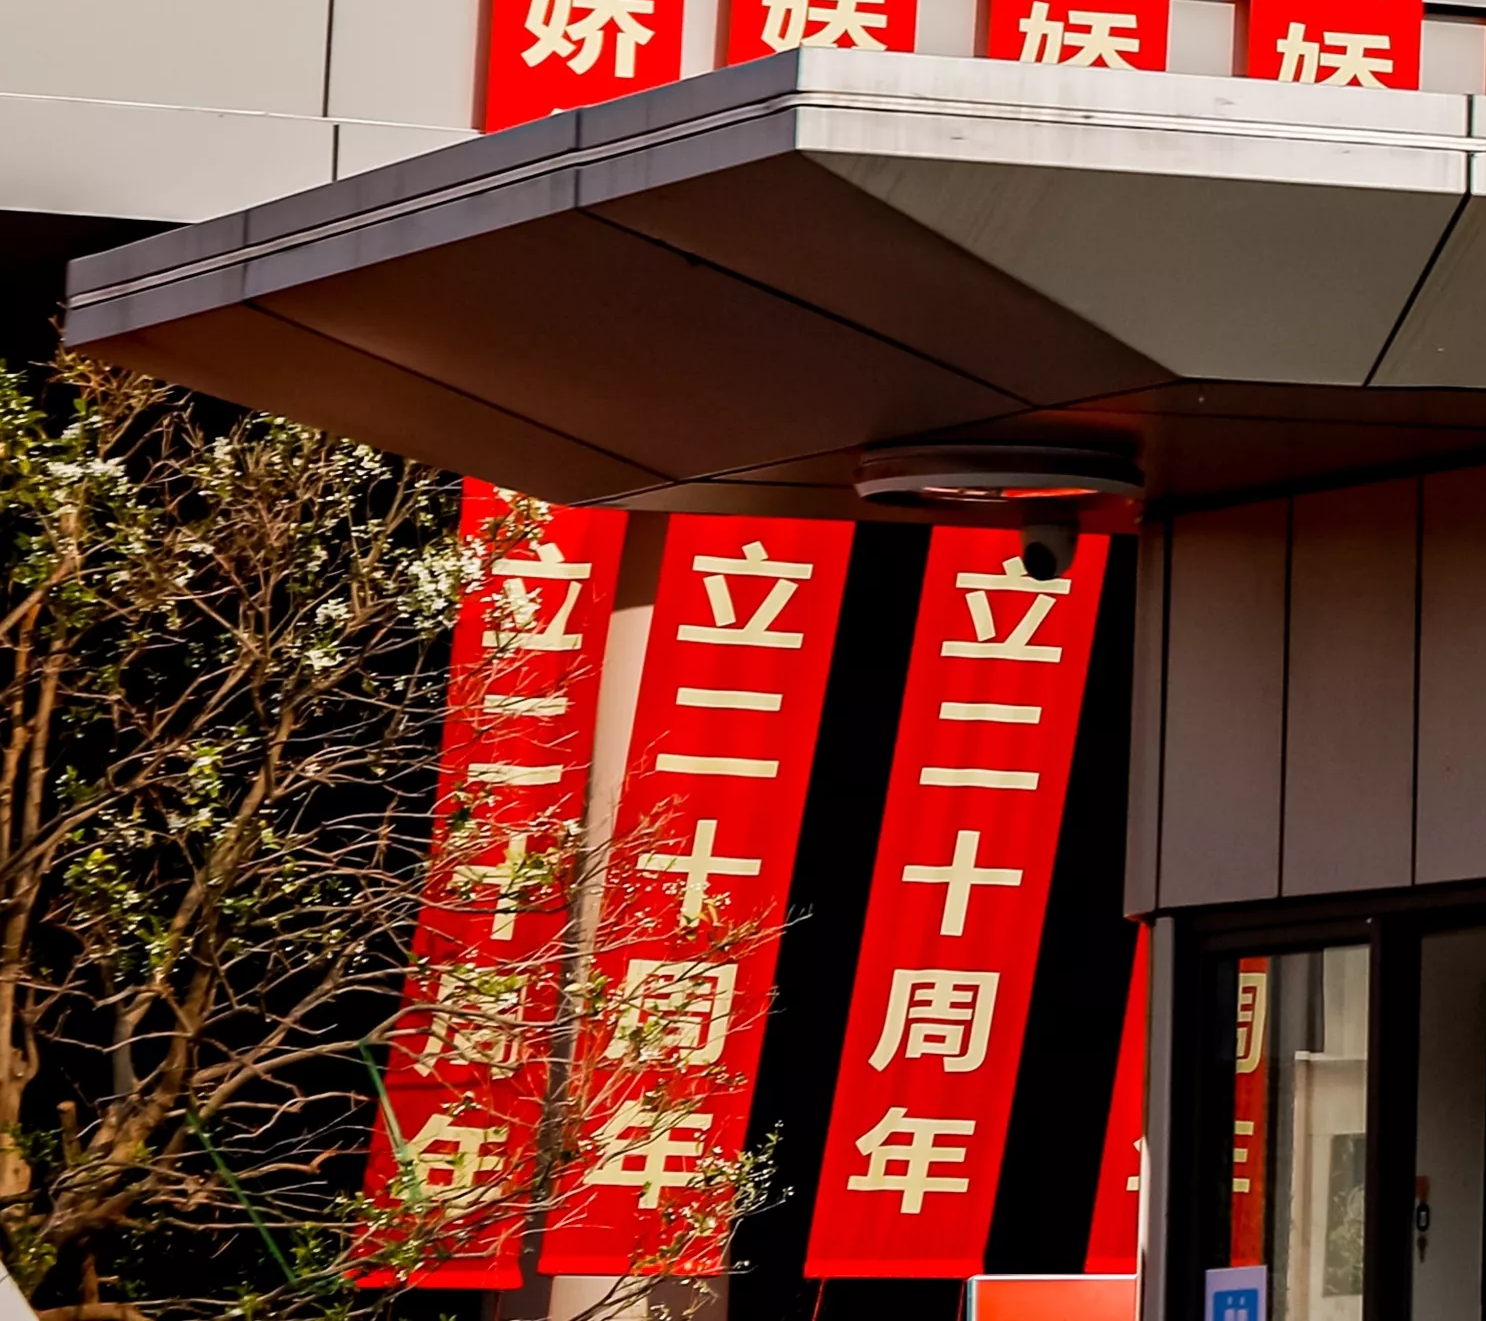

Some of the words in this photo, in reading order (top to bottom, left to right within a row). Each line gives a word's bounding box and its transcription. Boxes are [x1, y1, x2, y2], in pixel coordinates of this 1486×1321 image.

[582, 540, 814, 1211] 立二十周年
[846, 555, 1072, 1215] 立二十周年
